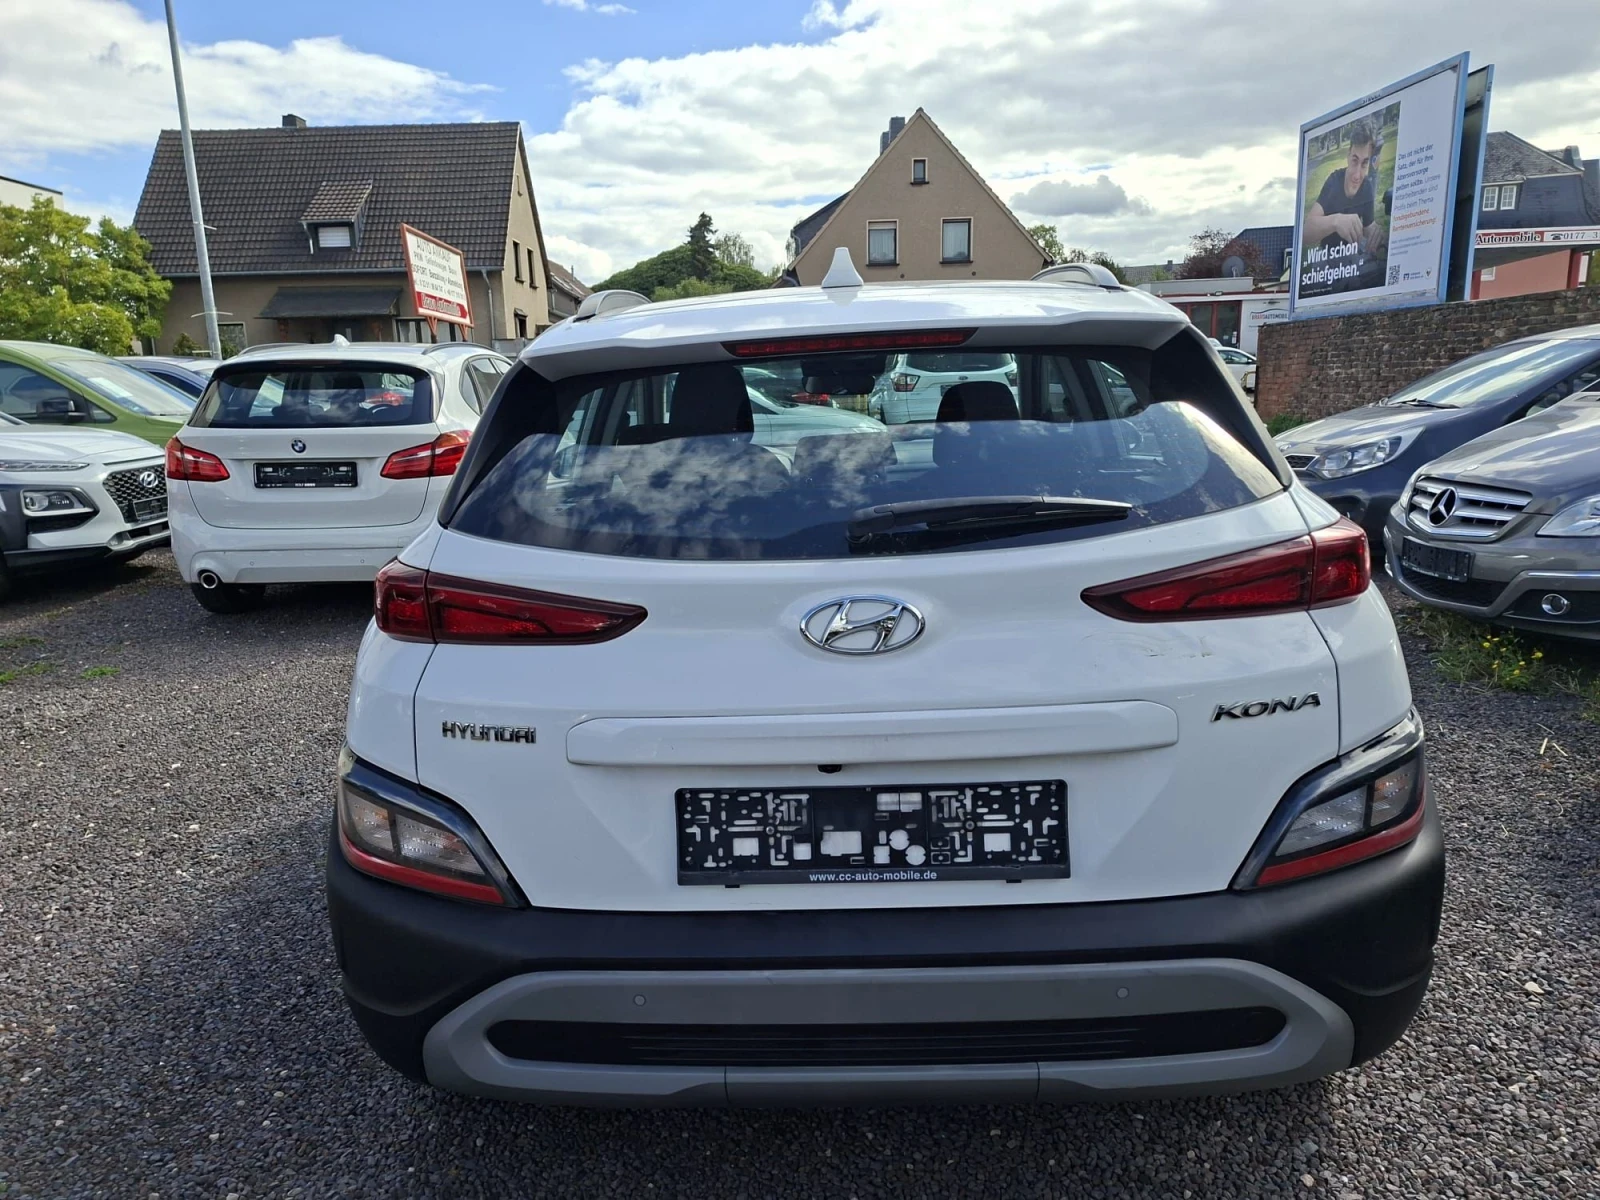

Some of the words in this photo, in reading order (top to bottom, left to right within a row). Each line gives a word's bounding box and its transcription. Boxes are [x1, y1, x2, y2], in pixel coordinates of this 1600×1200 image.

[1476, 232, 1541, 244] Automobile
[1563, 232, 1586, 240] 0177
[1329, 240, 1358, 260] schon
[1211, 692, 1321, 722] KONA
[442, 721, 537, 744] HYUNDAI
[809, 870, 938, 881] www.cc-auto-mobile.de
